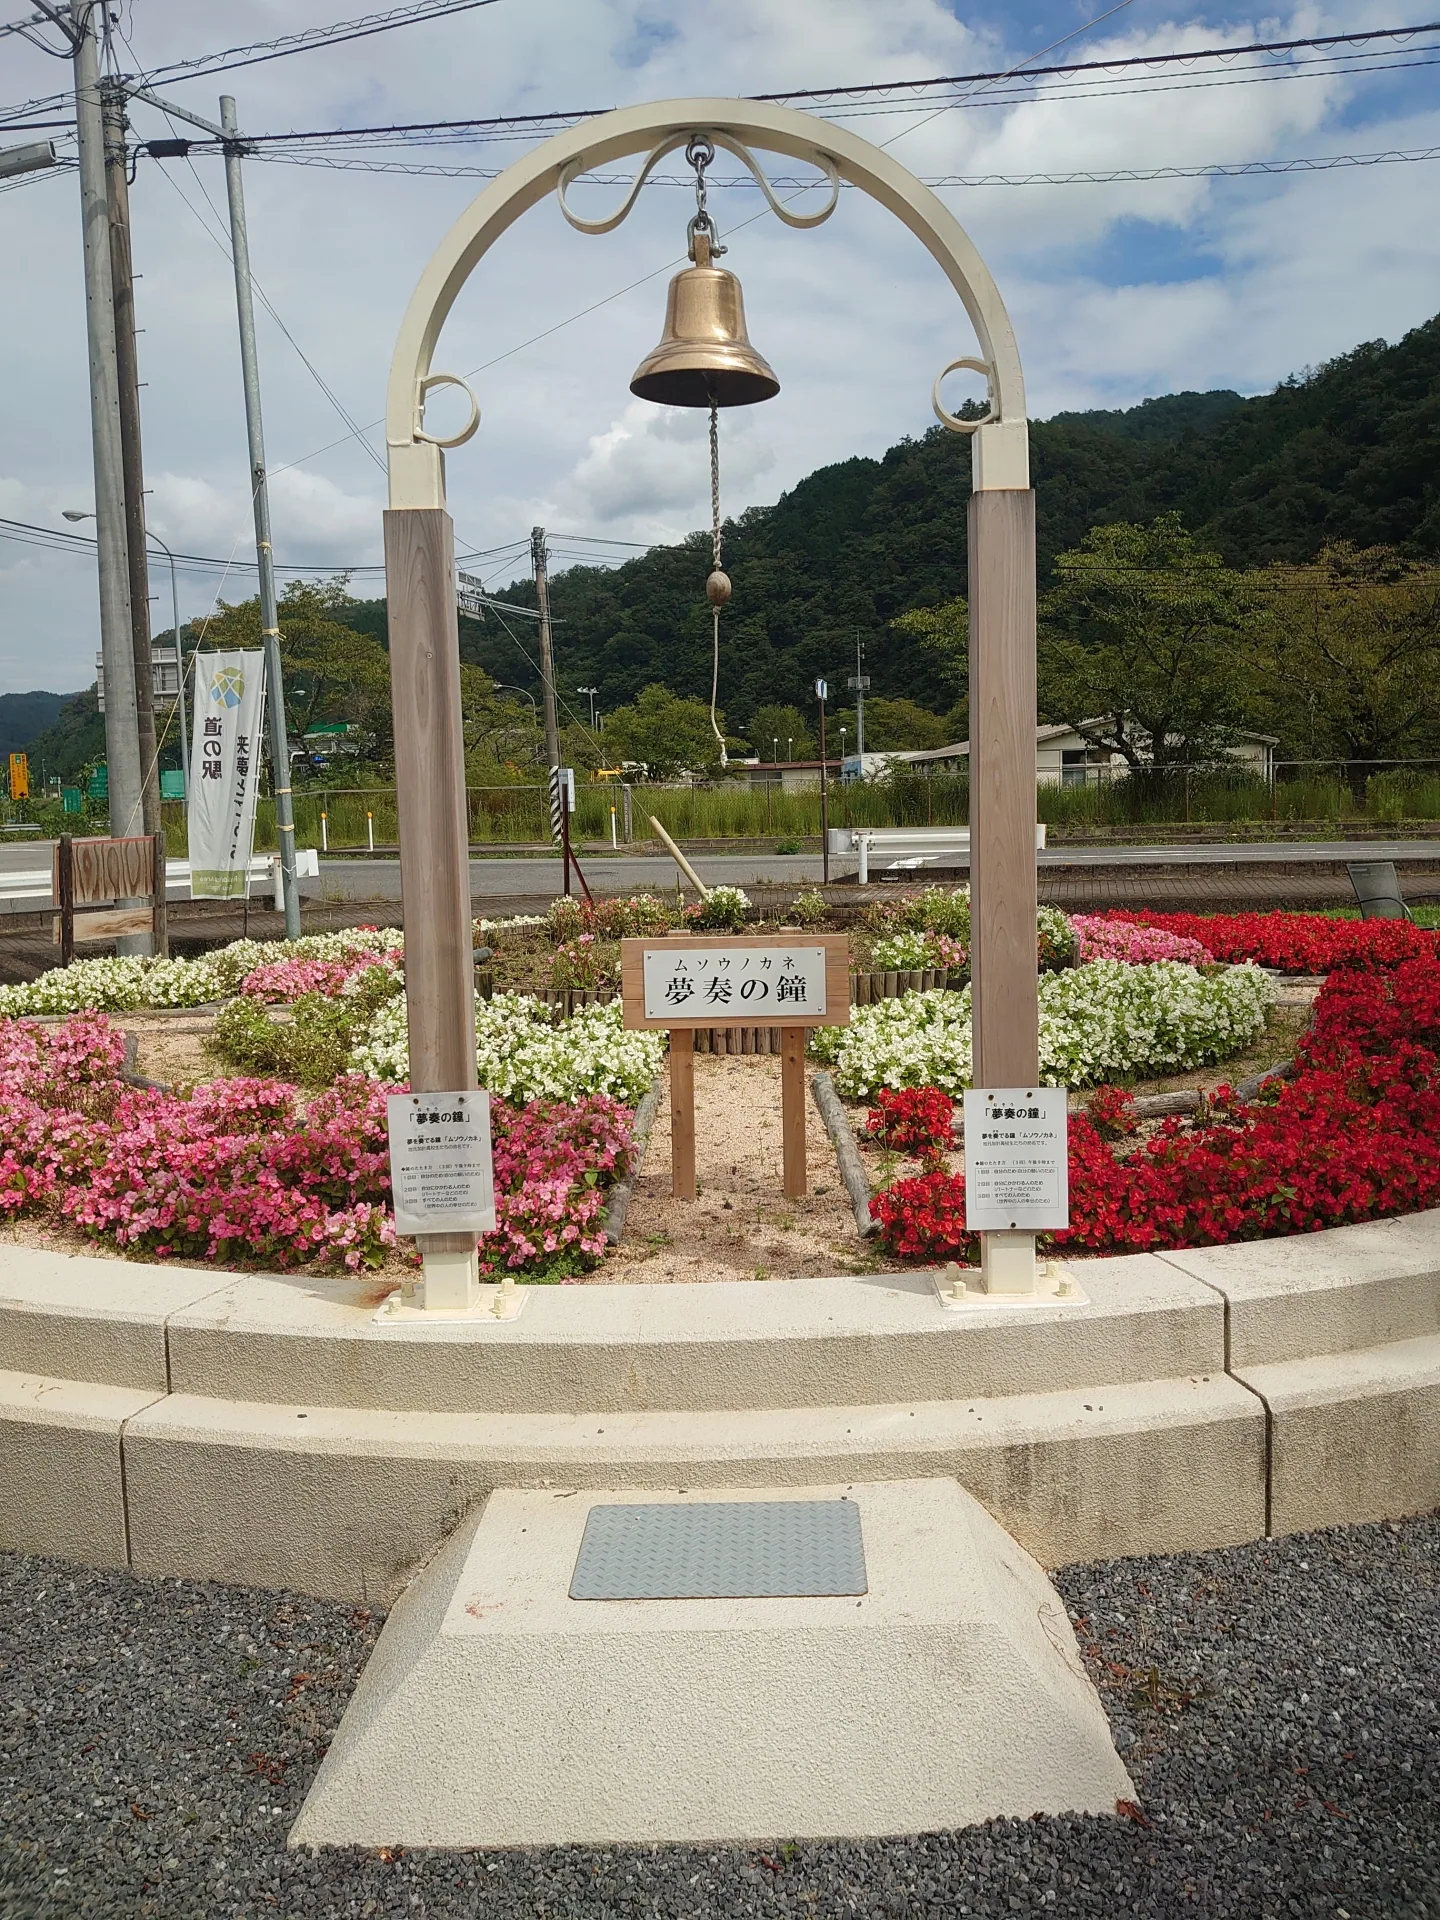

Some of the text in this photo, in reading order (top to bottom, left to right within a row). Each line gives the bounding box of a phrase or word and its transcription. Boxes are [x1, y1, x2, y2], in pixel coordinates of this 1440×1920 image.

[674, 956, 796, 973] ムソウノカネ
[664, 975, 808, 1006] 夢奏の鐘
[410, 1111, 471, 1124] 「夢奏の鐘」
[986, 1108, 1046, 1119] 「夢奏の鐘」
